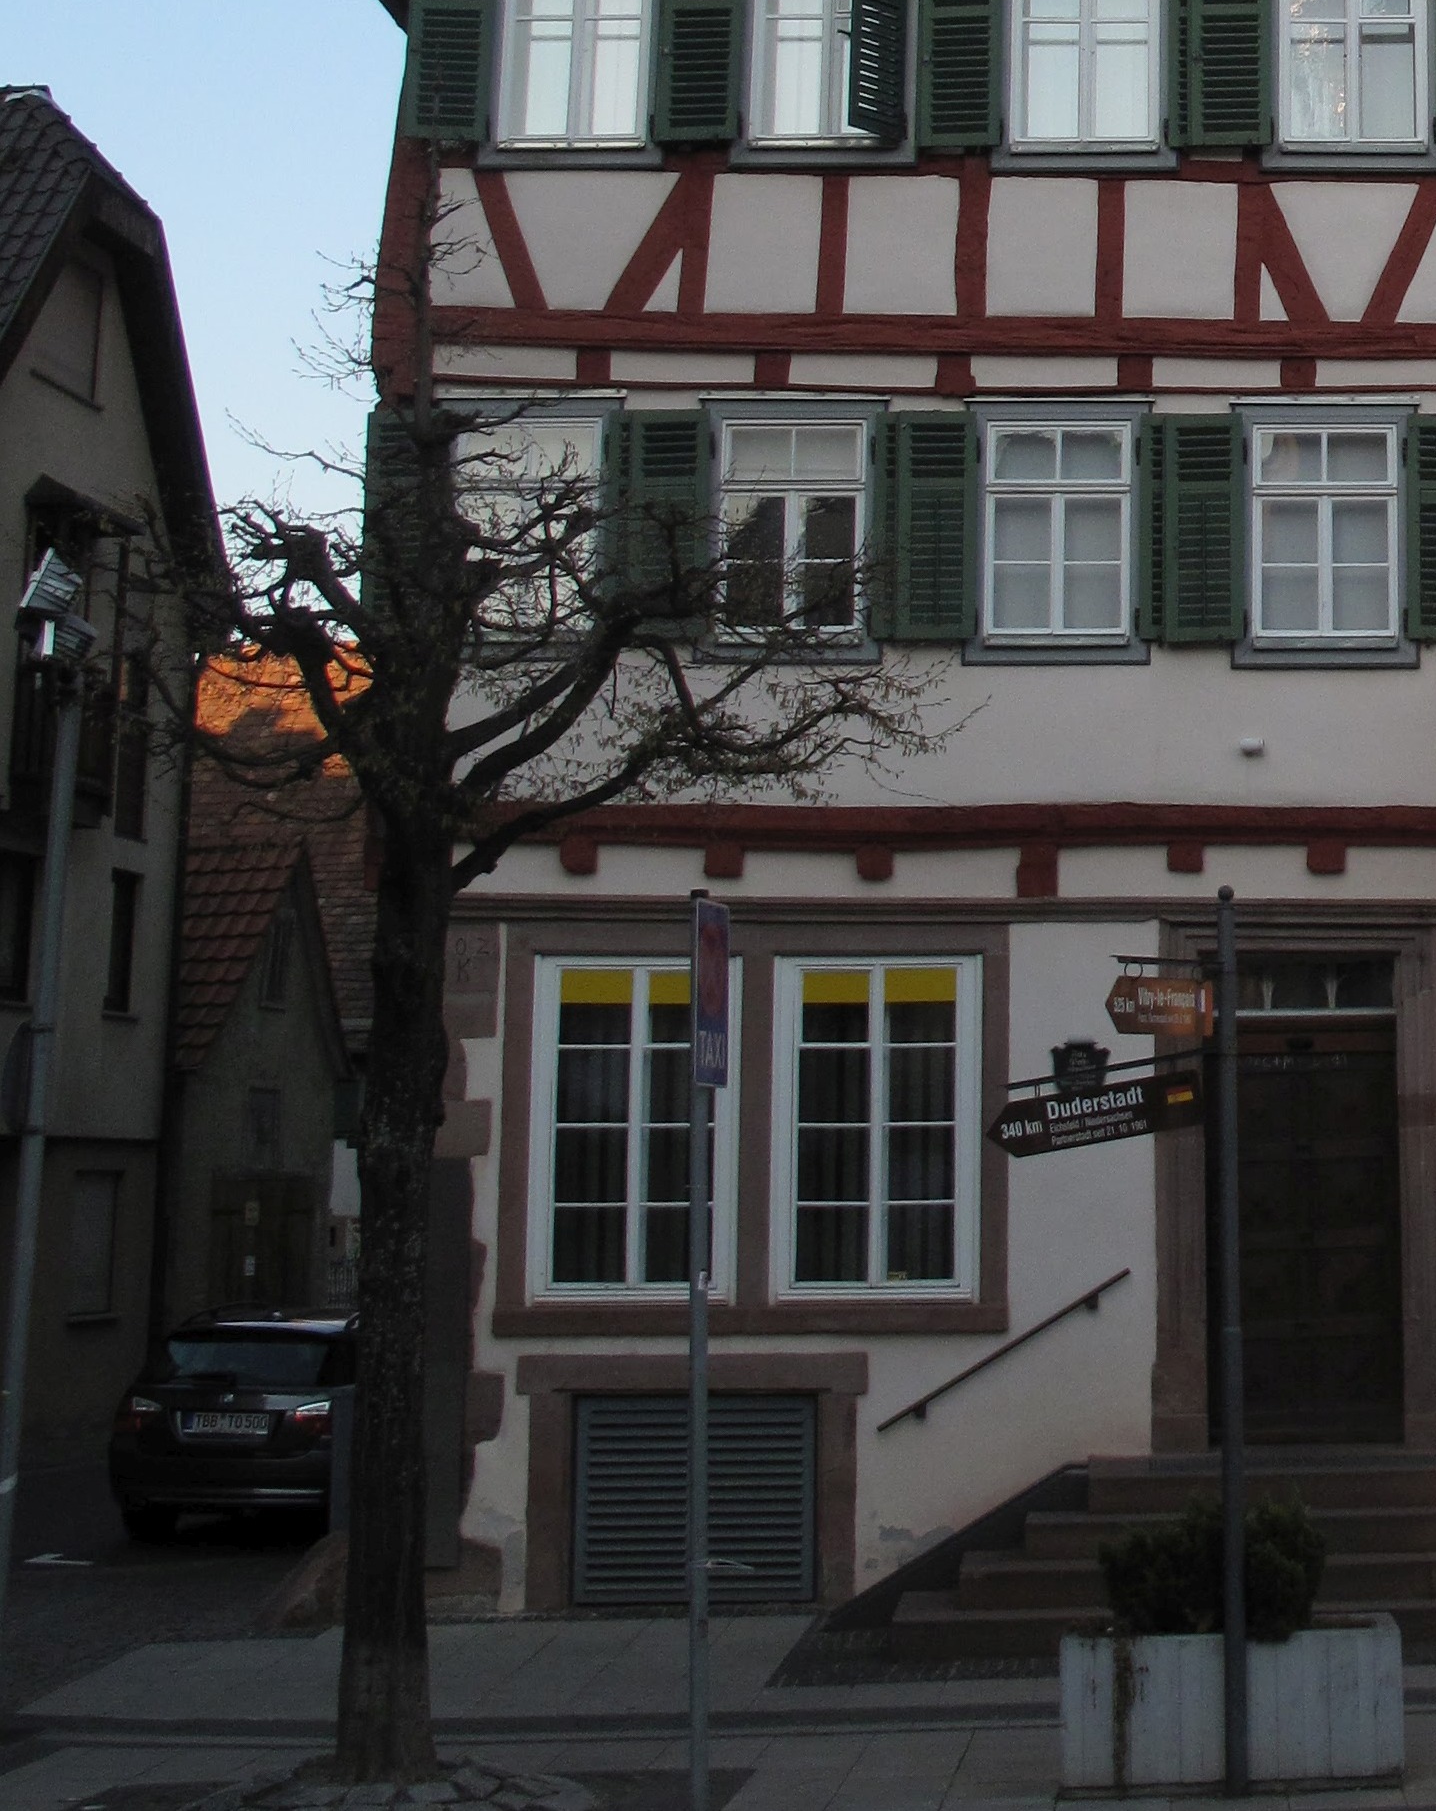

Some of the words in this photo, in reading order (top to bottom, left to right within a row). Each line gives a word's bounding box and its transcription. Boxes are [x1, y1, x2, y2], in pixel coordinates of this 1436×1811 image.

[698, 1030, 726, 1069] TAXI
[1046, 1087, 1144, 1119] Duderstadt
[1000, 1122, 1022, 1140] 340
[1024, 1118, 1044, 1136] km
[1049, 1118, 1080, 1133] Eichsfeld
[1085, 1110, 1134, 1127] Niedersachsen
[1051, 1129, 1092, 1146] Partnerstadt
[1092, 1127, 1106, 1138] seit
[196, 1414, 218, 1428] TBB
